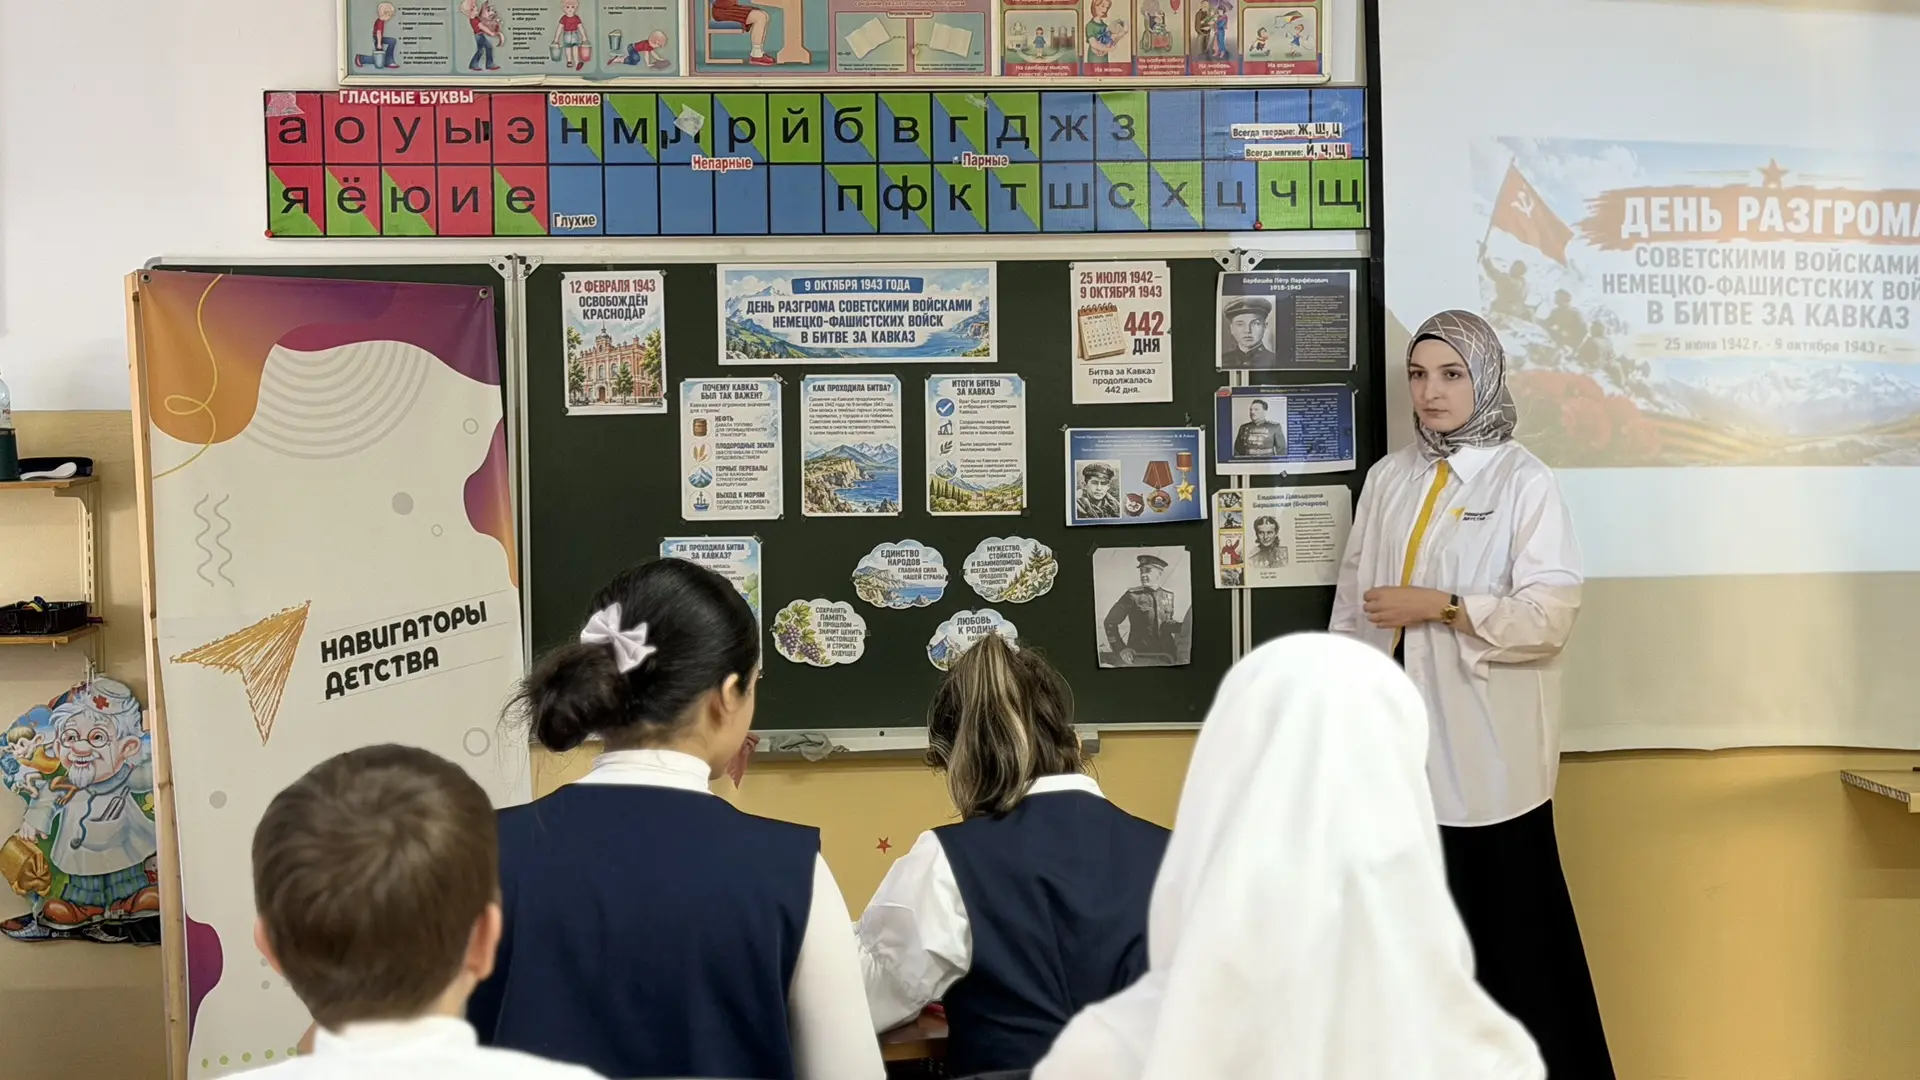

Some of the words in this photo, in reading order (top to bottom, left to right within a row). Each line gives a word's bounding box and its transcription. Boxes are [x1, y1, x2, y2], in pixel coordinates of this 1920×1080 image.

[339, 91, 415, 105] ГЛАСНЫЕ
[419, 90, 474, 104] БУКВЫ
[551, 92, 600, 106] Звонкие
[279, 116, 308, 144] а
[334, 116, 365, 144] о
[392, 116, 421, 154] у
[445, 117, 482, 144] ы
[507, 116, 535, 144] э
[561, 117, 588, 144] н
[613, 117, 648, 144] м
[728, 116, 756, 153] р
[782, 107, 810, 144] й
[834, 106, 864, 144] б
[894, 116, 920, 143] в
[949, 116, 969, 143] г
[996, 115, 1030, 149] д
[1050, 115, 1089, 142] ж
[1112, 114, 1135, 141] з
[1233, 128, 1259, 137] Всегда
[1298, 124, 1312, 136] Ж,
[1315, 124, 1330, 136] Ш,
[1332, 123, 1341, 136] Ц
[1246, 149, 1272, 157] Всегда
[1321, 144, 1332, 157] Ч,
[1335, 144, 1346, 157] Щ
[693, 156, 752, 171] Непарные
[962, 153, 1009, 168] Парные
[281, 186, 309, 214] я
[337, 177, 366, 214] ё
[391, 186, 430, 214] ю
[452, 186, 479, 213] и
[506, 186, 535, 213] е
[837, 184, 863, 211] п
[883, 175, 927, 220] ф
[949, 184, 973, 211] к
[1000, 183, 1026, 210] т
[1049, 183, 1089, 209] ш
[1108, 182, 1136, 210] с
[1161, 182, 1190, 208] х
[1217, 181, 1246, 214] ц
[1271, 180, 1296, 207] ч
[1319, 179, 1362, 214] щ
[553, 214, 597, 230] Глухие
[1621, 197, 1722, 239] ДЕНЬ
[1635, 247, 1786, 271] СОВЕТСКИМИ
[1795, 247, 1919, 275] ВОЙСКАМИ
[1080, 272, 1093, 284] 25
[1096, 271, 1127, 284] ИЮЛЯ
[1130, 271, 1153, 283] 1942
[570, 280, 581, 293] 12
[584, 279, 630, 293] ФЕВРАЛЯ
[632, 279, 656, 292] 1943
[804, 280, 811, 291] 9
[814, 279, 858, 291] ОКТЯБРЯ
[861, 279, 883, 291] 1943
[885, 279, 911, 292] ГОДА
[1080, 287, 1087, 298] 9
[1090, 286, 1136, 298] ОКТЯБРЯ
[1139, 286, 1162, 298] 1943
[1602, 273, 1874, 300] НЕМЕЦКО-ФАШИСТСКИХ
[579, 293, 648, 308] ОСВОБОЖДЁН
[746, 300, 775, 314] ДЕНЬ
[778, 300, 835, 313] РАЗГРОМА
[839, 299, 910, 313] СОВЕТСКИМИ
[913, 297, 972, 312] ВОЙСКАМИ
[583, 308, 646, 321] КРАСНОДАР
[773, 315, 905, 330] НЕМЕЦКО-ФАШИСТСКИХ
[908, 312, 944, 327] ВОЙСК
[1647, 301, 1664, 325] В
[1674, 301, 1753, 327] БИТВЕ
[1762, 302, 1794, 327] ЗА
[1805, 303, 1910, 329] КАВКАЗ
[1124, 311, 1164, 336] 442
[801, 331, 808, 344] В
[812, 331, 848, 344] БИТВЕ
[853, 331, 867, 343] ЗА
[871, 330, 916, 343] КАВКАЗ
[1132, 338, 1160, 355] ДНЯ
[1664, 338, 1680, 350] 25
[1721, 338, 1749, 350] 1942
[1775, 338, 1782, 350] 9
[1787, 340, 1839, 353] октября
[1845, 341, 1875, 353] 1943
[1088, 368, 1114, 376] Битва
[813, 384, 825, 392] КАК
[827, 384, 865, 392] ПРОХОДИЛА
[867, 384, 891, 392] БИТВА?
[1093, 378, 1153, 386] продолжалась
[701, 392, 717, 400] БЫЛ
[719, 392, 732, 400] ТАК
[1105, 386, 1120, 394] 442
[881, 550, 919, 559] ЕДИНСТВО
[957, 616, 991, 625] ЛЮБОВЬ
[320, 601, 487, 663] НАВИГАТОРЫ
[325, 646, 439, 700] ДЕТСТВА
